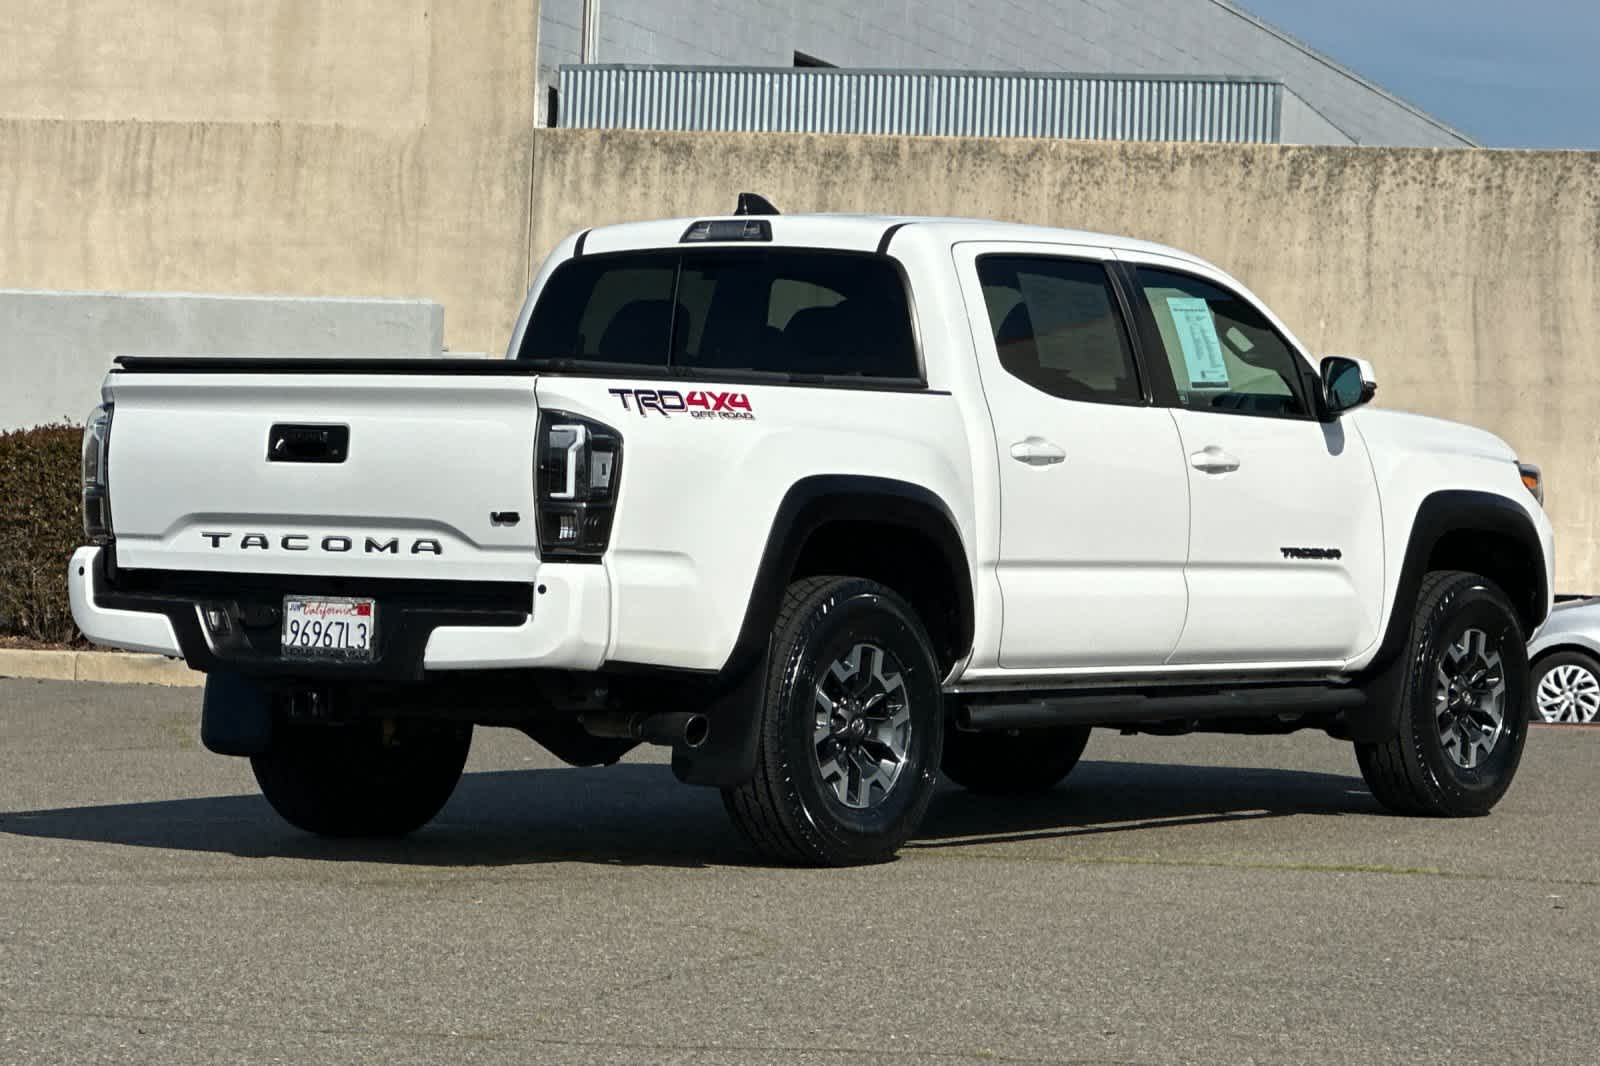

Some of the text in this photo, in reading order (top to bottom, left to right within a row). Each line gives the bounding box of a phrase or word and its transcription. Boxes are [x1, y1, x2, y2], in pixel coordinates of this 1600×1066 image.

[608, 388, 687, 417] TRD
[690, 410, 754, 420] OFF ROAD
[201, 531, 442, 555] TACOMA
[1280, 547, 1342, 560] TACOMA
[303, 600, 352, 619] California
[290, 619, 367, 649] 96967L3
